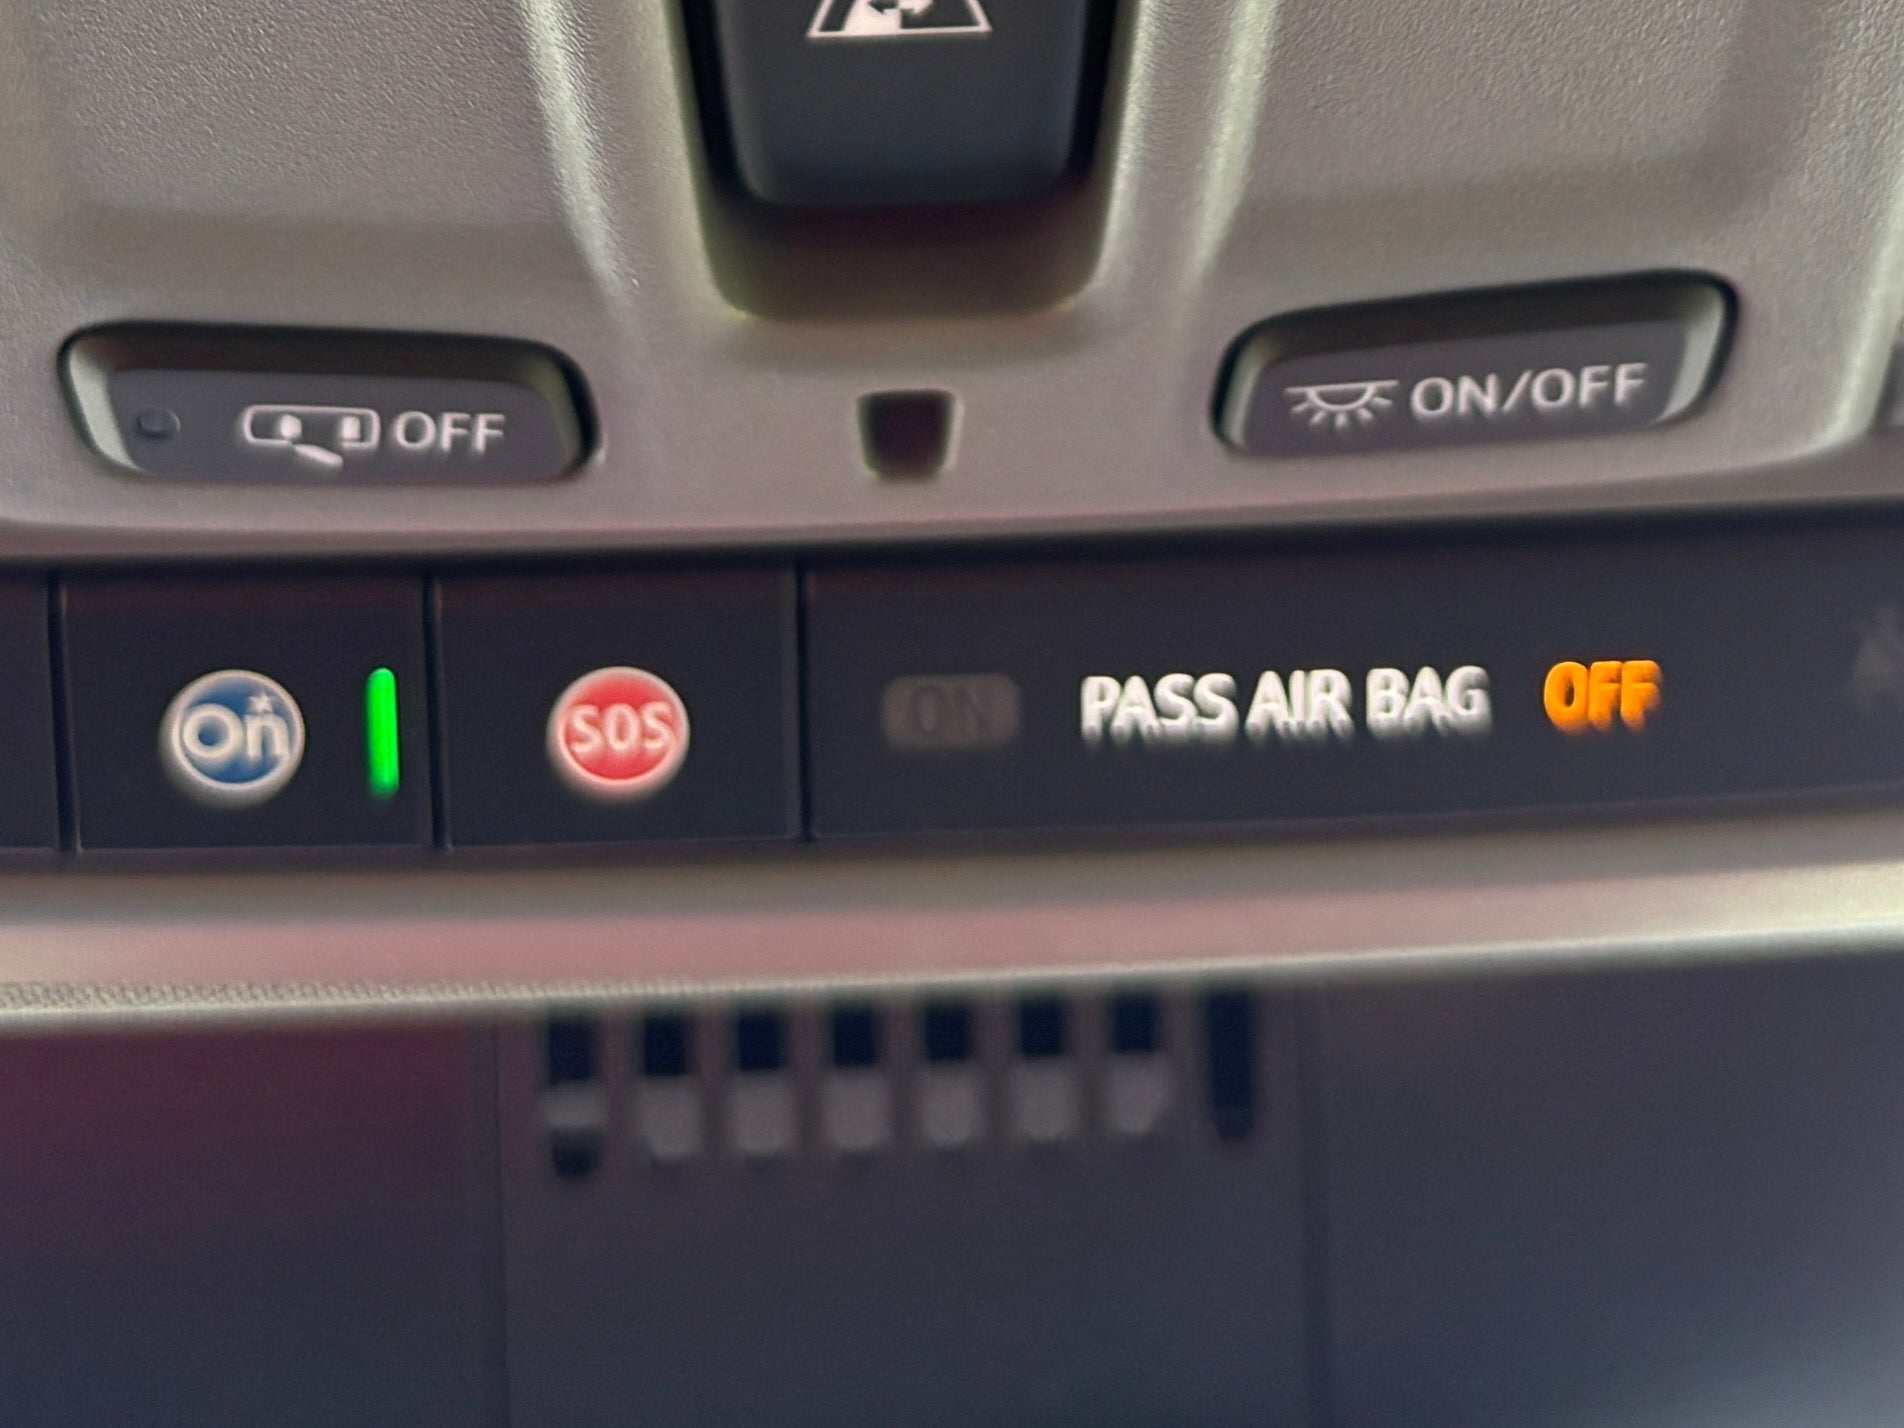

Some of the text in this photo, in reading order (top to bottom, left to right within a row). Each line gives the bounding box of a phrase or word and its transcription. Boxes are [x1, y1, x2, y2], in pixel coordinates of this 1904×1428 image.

[1410, 361, 1647, 420] ON/OFF
[392, 409, 506, 454] OFF
[568, 700, 676, 756] SOS
[1081, 673, 1237, 742] PASS
[1245, 669, 1353, 741] AIR
[1365, 665, 1491, 740] BAG
[1542, 660, 1663, 735] OFF
